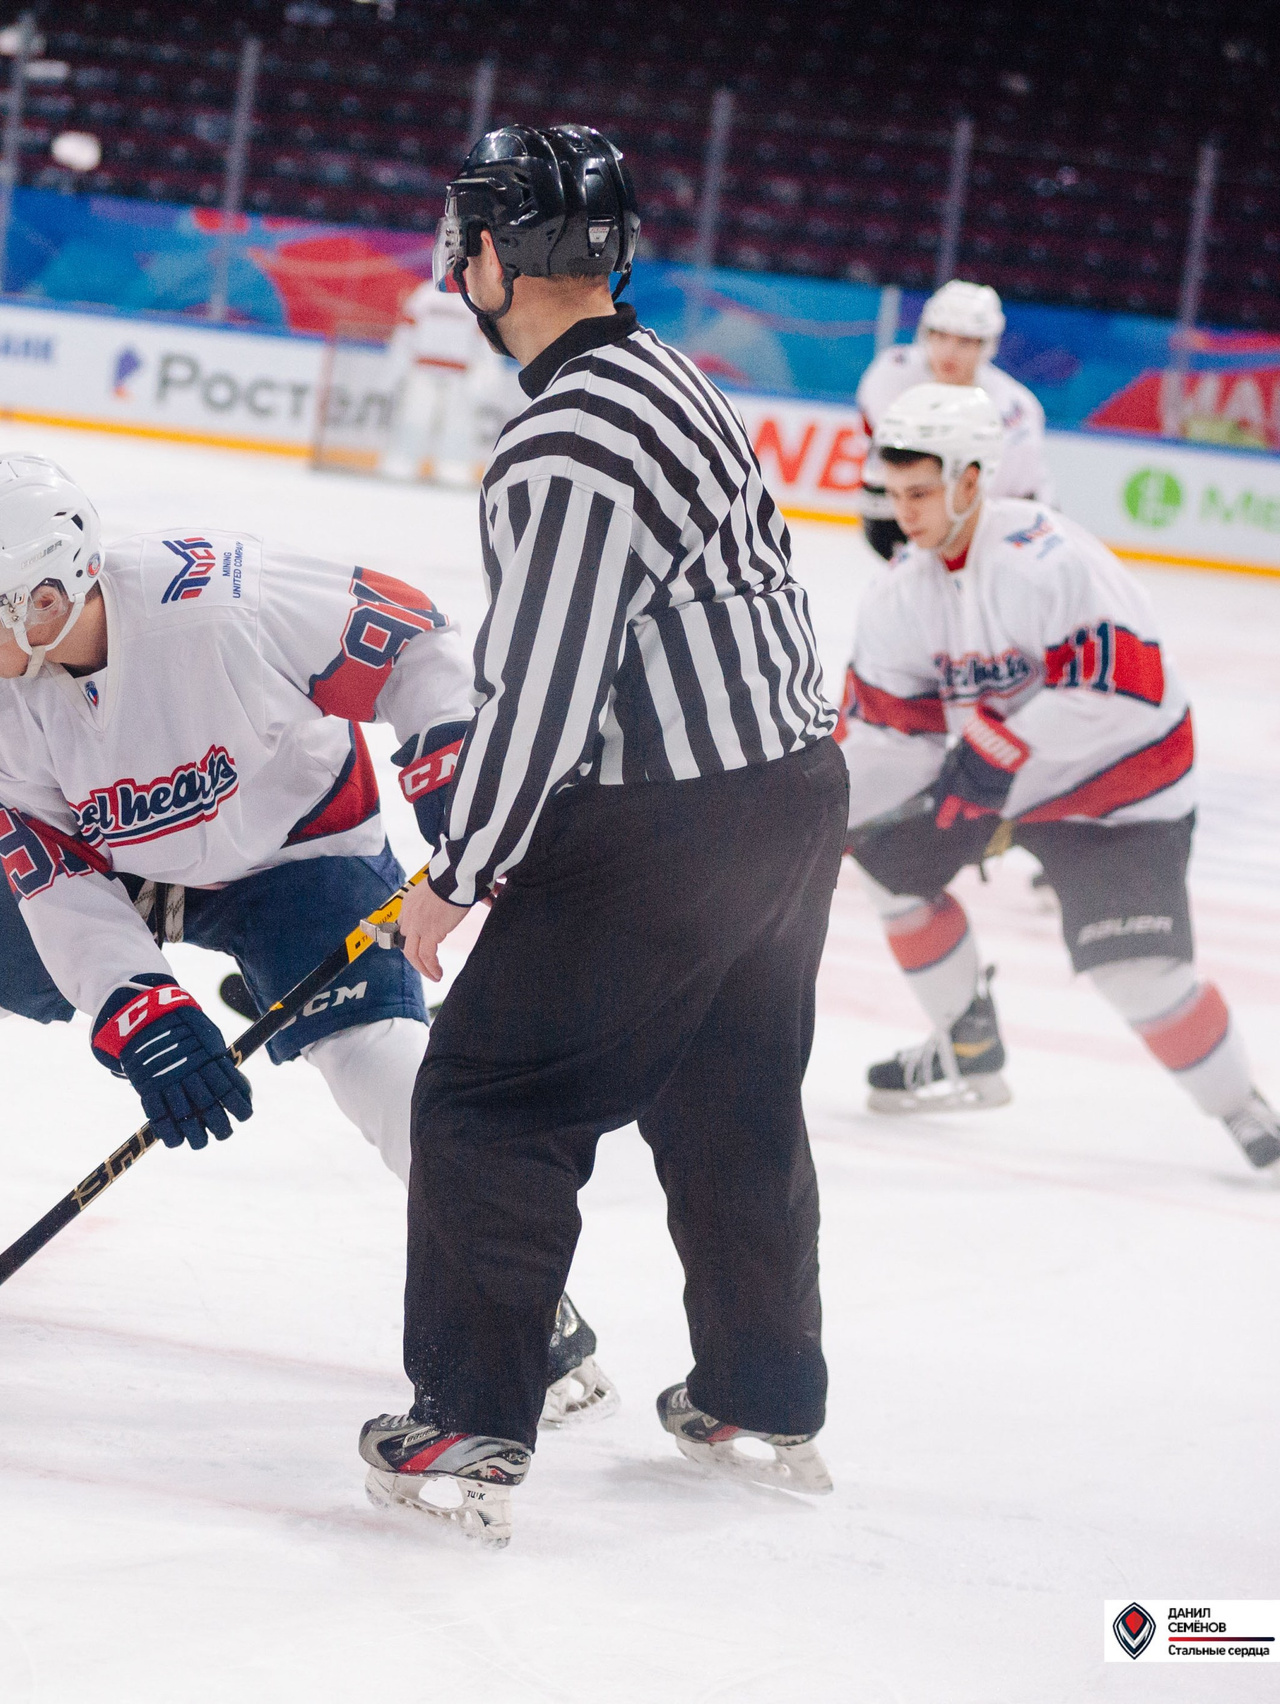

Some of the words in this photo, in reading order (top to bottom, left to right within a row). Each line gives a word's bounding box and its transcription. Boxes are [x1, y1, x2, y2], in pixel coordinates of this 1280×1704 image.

[222, 551, 232, 577] MINING
[232, 568, 242, 599] UNITED
[115, 986, 190, 1037] CC
[280, 981, 368, 1030] CM
